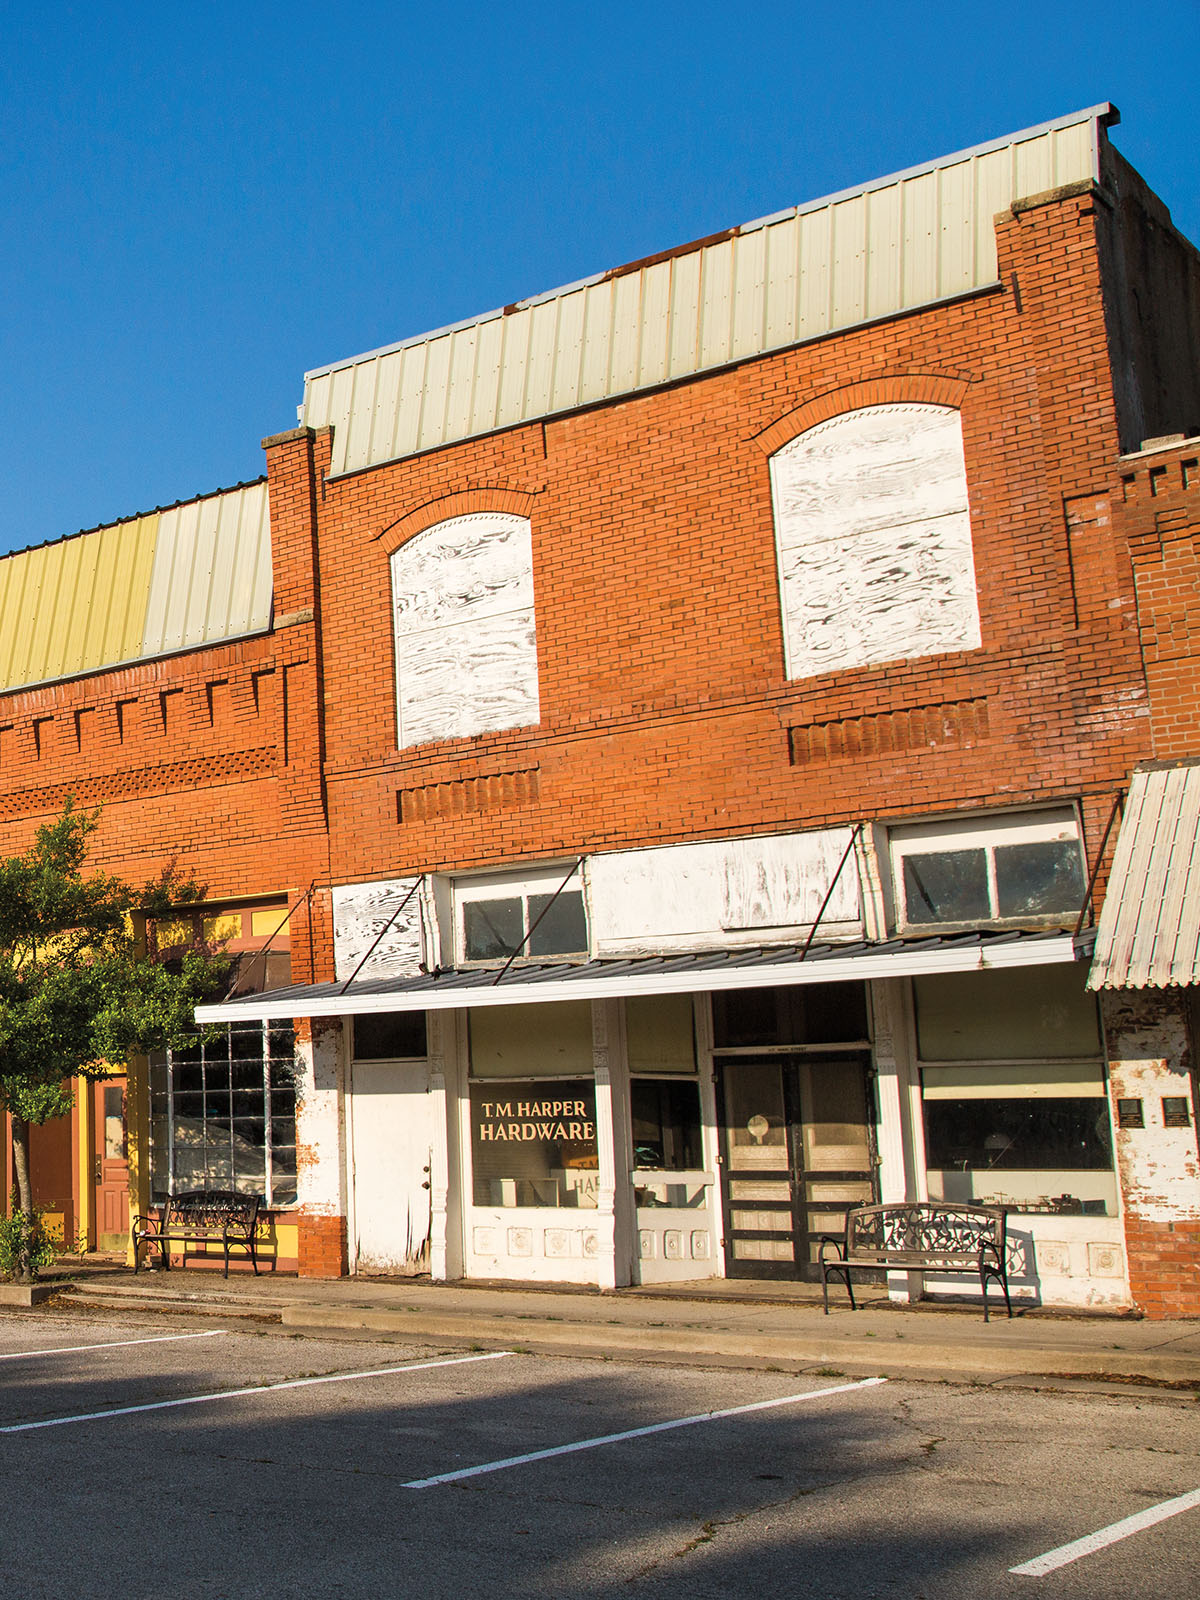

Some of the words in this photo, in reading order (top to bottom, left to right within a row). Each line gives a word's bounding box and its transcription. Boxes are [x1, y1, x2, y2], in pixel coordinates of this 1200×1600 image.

[481, 1102, 515, 1118] T.M.
[517, 1101, 587, 1118] HARPER
[479, 1122, 595, 1141] HARDWARE
